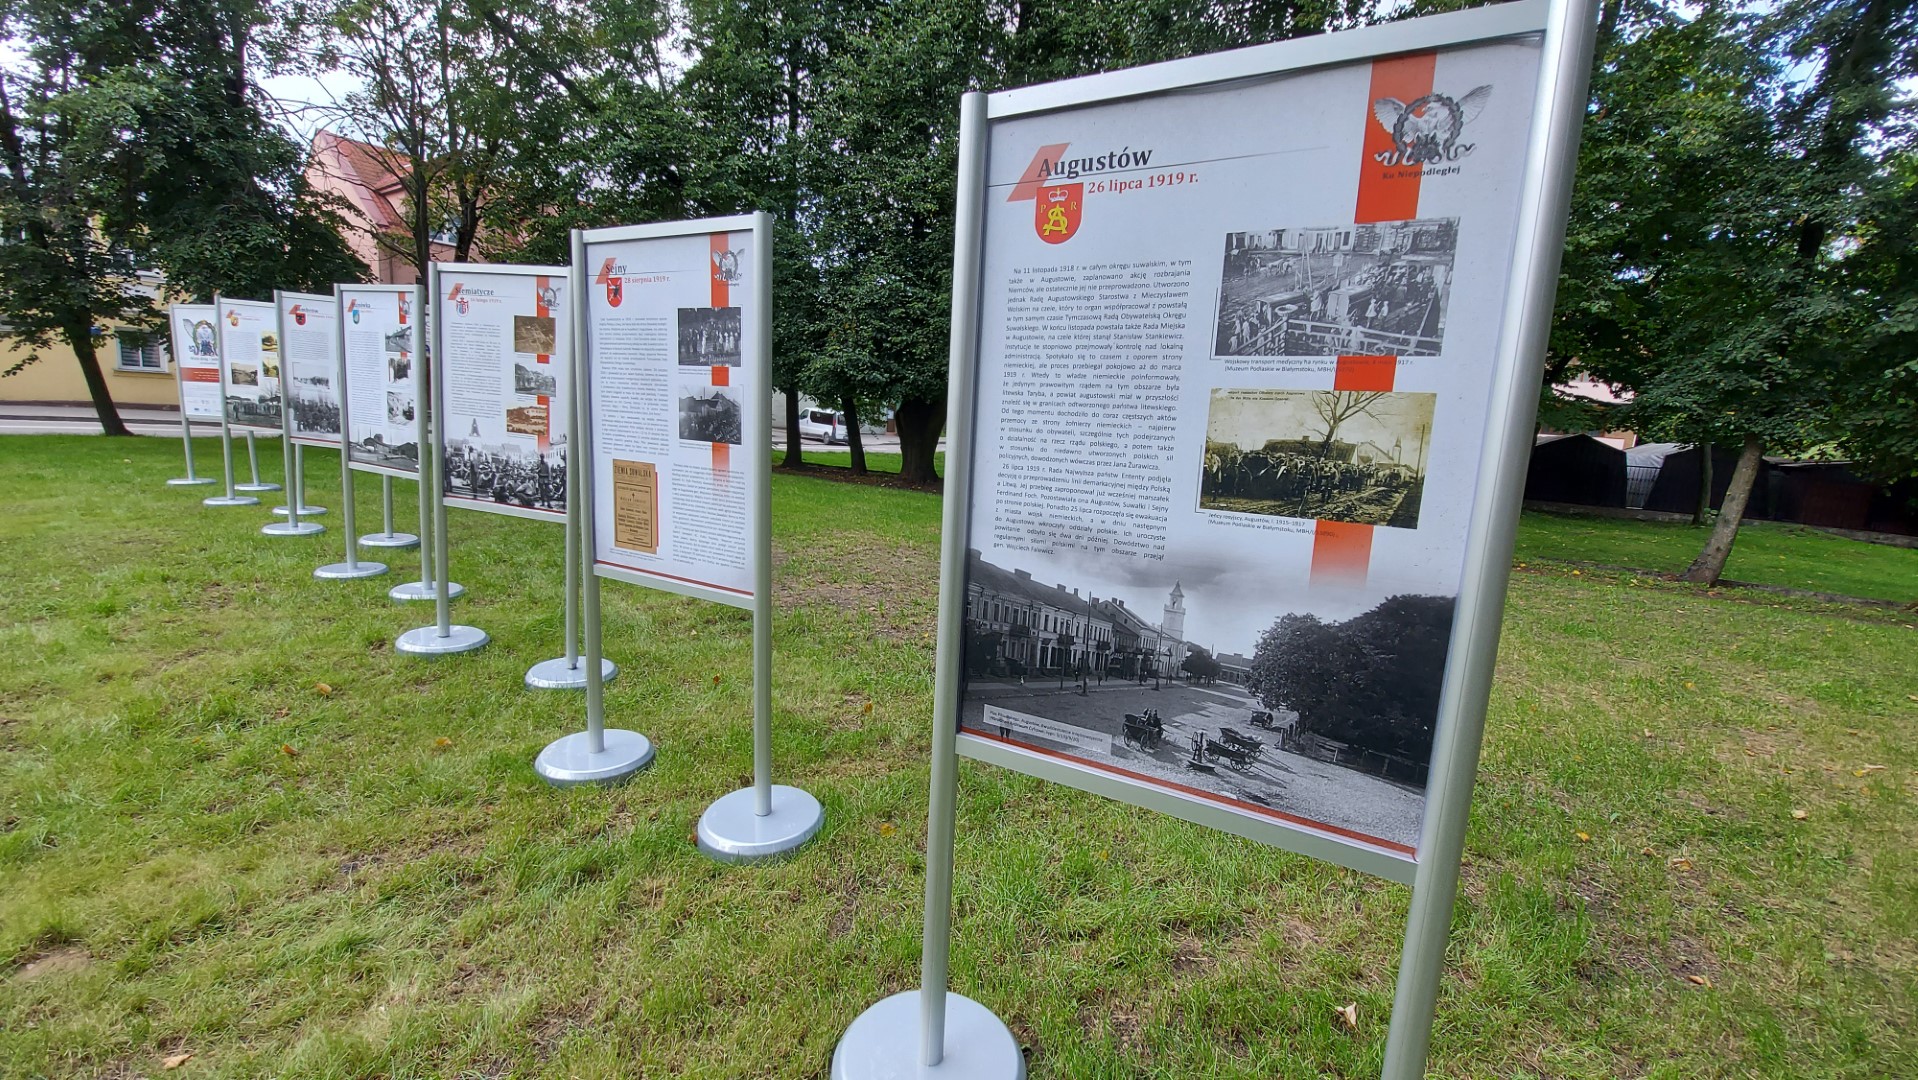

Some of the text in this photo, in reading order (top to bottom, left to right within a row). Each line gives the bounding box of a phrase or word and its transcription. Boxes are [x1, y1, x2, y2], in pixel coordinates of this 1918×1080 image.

[1037, 146, 1152, 179] Augustów
[1088, 172, 1198, 194] 26 lipca 1919 r.
[606, 264, 627, 275] Sejny
[1060, 263, 1074, 272] 1918
[1108, 260, 1130, 271] okręgu
[1132, 259, 1168, 270] suwalskim,
[1177, 257, 1192, 268] tym
[1129, 271, 1146, 281] akcję
[1153, 269, 1190, 280] rozbrajania
[1152, 280, 1190, 288] Utworzono
[1098, 292, 1129, 300] Starostwa
[1140, 290, 1188, 301] Mieczysławem
[1162, 311, 1186, 321] Okręgu
[1159, 322, 1185, 331] Miejska
[1115, 343, 1141, 352] kontrolę
[1161, 353, 1183, 362] strony
[1105, 363, 1135, 372] pokojowo
[1117, 382, 1129, 391] tym
[1144, 393, 1179, 403] przyszłości
[1140, 403, 1178, 413] litewskiego.
[1156, 413, 1177, 421] aktów
[1132, 432, 1175, 443] podejrzanych
[1157, 443, 1174, 451] także
[1150, 483, 1170, 494] Polską
[1093, 544, 1105, 554] tym
